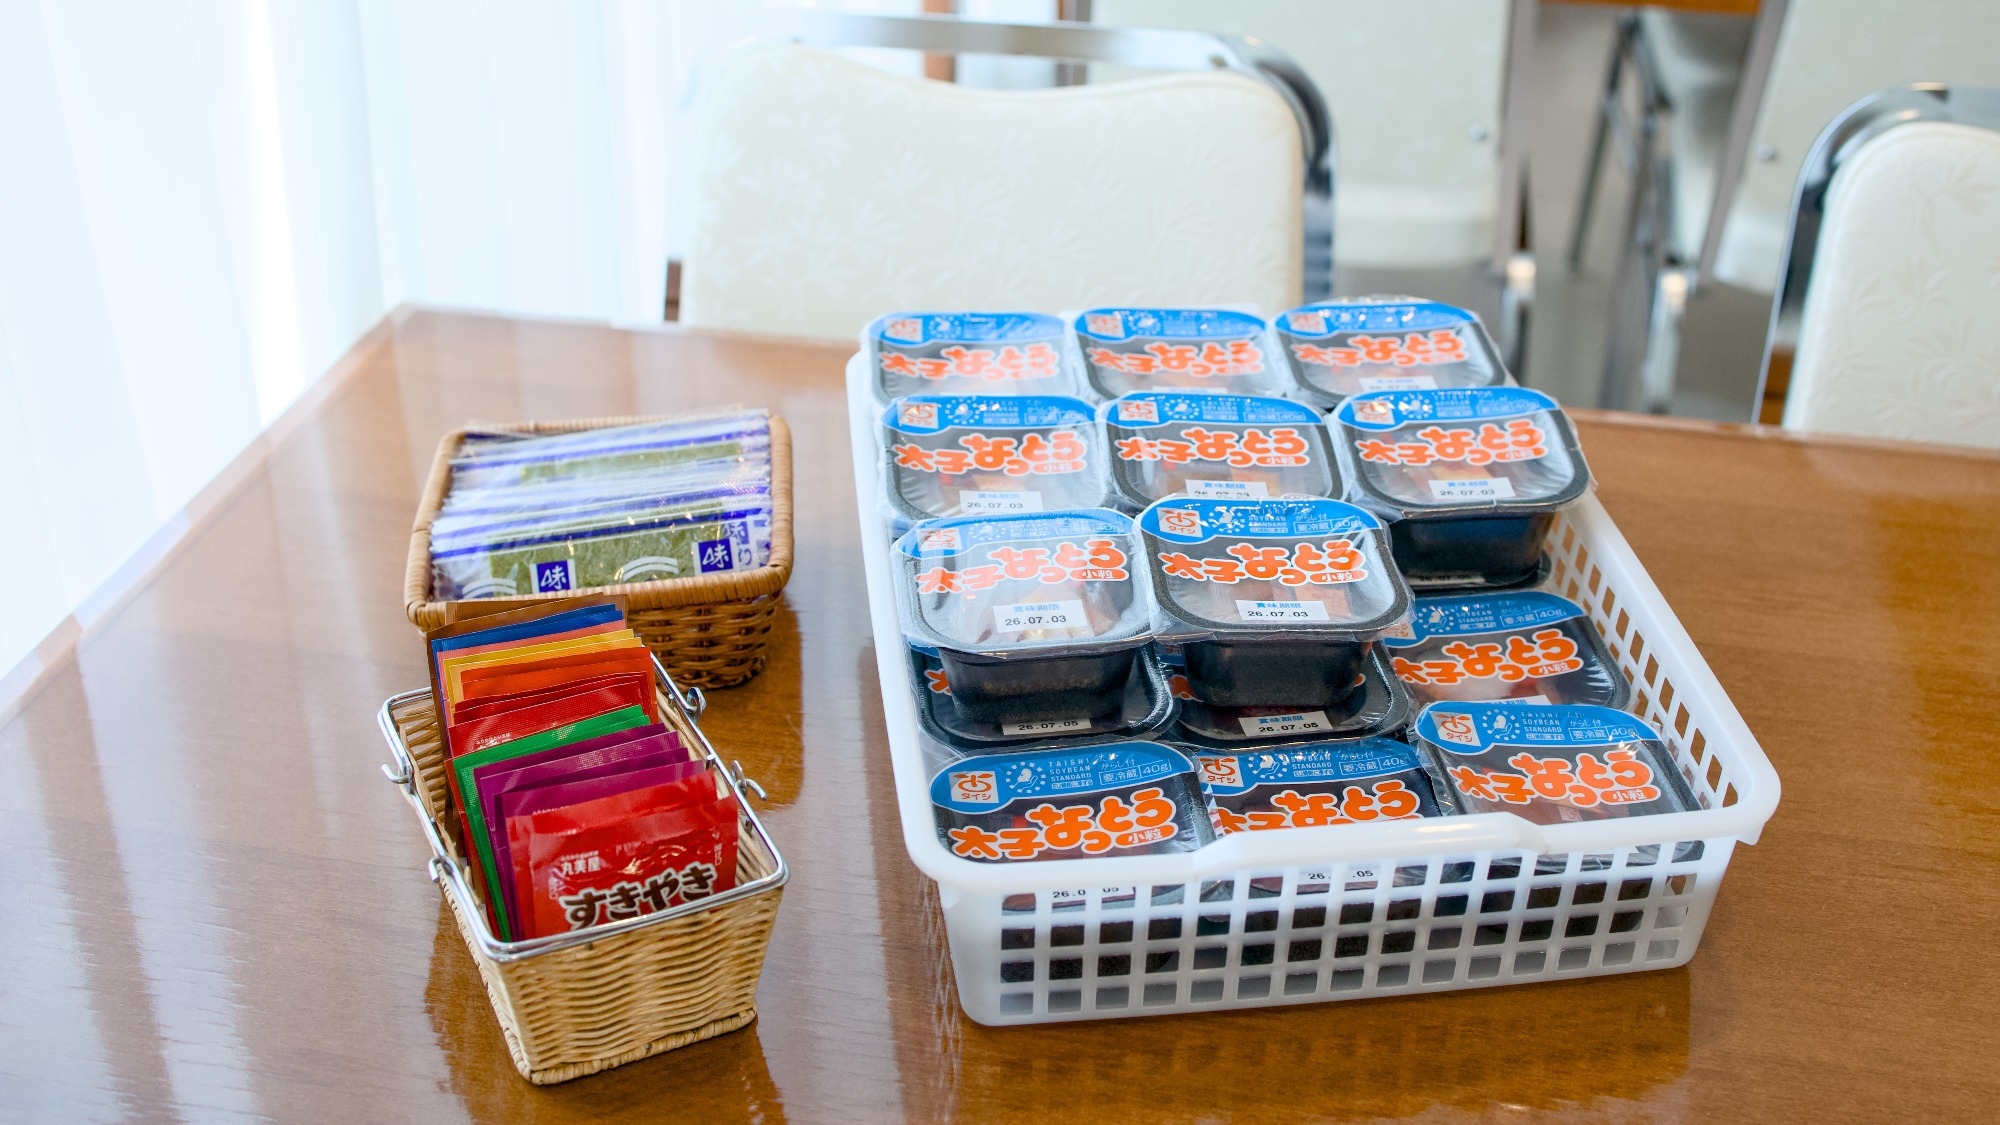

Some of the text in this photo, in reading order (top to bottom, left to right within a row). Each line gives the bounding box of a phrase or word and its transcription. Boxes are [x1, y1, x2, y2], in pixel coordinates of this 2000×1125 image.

[1290, 328, 1471, 367] 太子なっとう
[1115, 426, 1310, 466] 太子なっとう
[1355, 419, 1547, 466] 太子なっとう
[893, 430, 1086, 476] 太子なっとう
[1440, 489, 1496, 497] 26.07.03
[1168, 525, 1197, 535] タイシ
[702, 543, 730, 569] 味
[1158, 539, 1366, 586] 太子なっとう
[915, 539, 1128, 594] 太子なっとう
[540, 564, 568, 591] 味
[1081, 569, 1115, 580] 小粒
[1320, 571, 1355, 582] 小粒
[1005, 615, 1067, 626] 26.07.03
[1247, 610, 1309, 618] 26.07.03
[1391, 629, 1580, 686] 太子なっとう
[1539, 662, 1571, 676] 小粒
[1018, 720, 1079, 731] 26.07.05
[1258, 722, 1319, 733] 26.07.05
[1522, 718, 1561, 727] SOYBEAN
[1523, 725, 1563, 734] STANDARD
[1572, 729, 1607, 740] 要冷蔵
[1446, 731, 1474, 744] タイシ
[1048, 757, 1090, 768] TAISHI
[1292, 762, 1332, 770] STANDARD
[1049, 765, 1092, 775] SOYBEAN
[1103, 769, 1139, 783] 要冷蔵
[1142, 763, 1170, 776] 40g
[1050, 773, 1092, 782] STANDARD
[1207, 775, 1236, 784] タイシ
[1450, 751, 1655, 808] 太子なっとう
[961, 792, 992, 801] タイシ
[1611, 789, 1647, 802] 小粒
[1216, 780, 1420, 833] 太子なとう
[951, 787, 1176, 860] 太子なっとう
[1127, 828, 1163, 844] 小粒
[561, 856, 602, 876] 丸美屋
[1307, 869, 1374, 880] 26..05
[559, 860, 718, 932] すきやき
